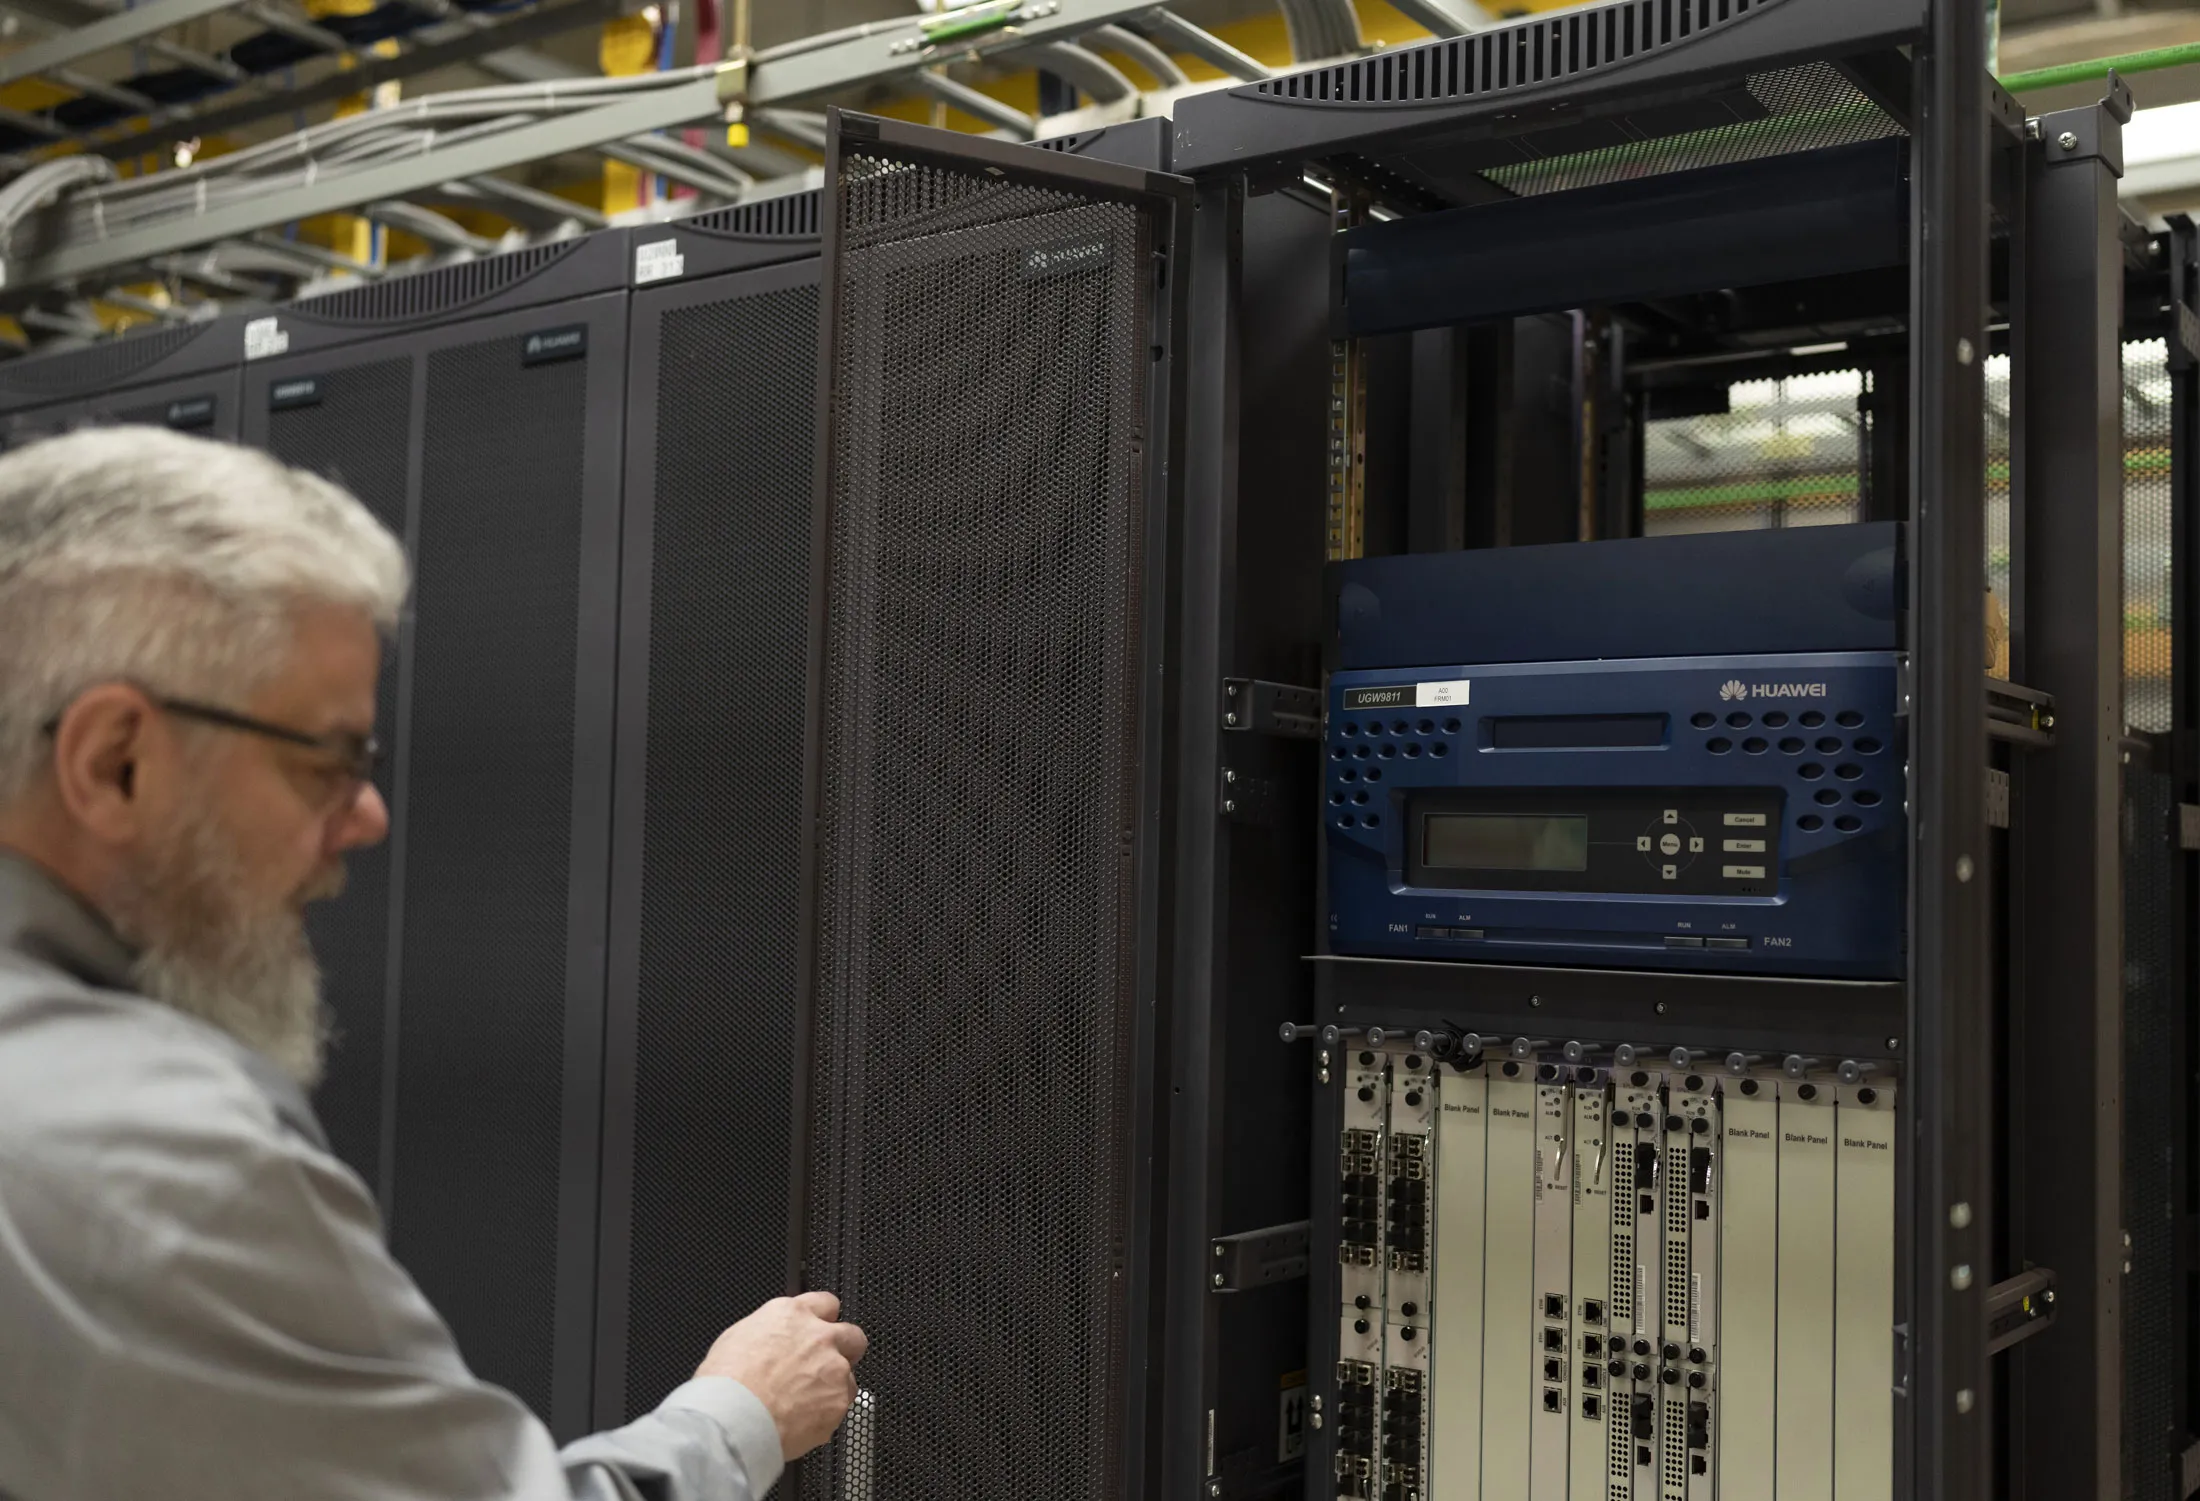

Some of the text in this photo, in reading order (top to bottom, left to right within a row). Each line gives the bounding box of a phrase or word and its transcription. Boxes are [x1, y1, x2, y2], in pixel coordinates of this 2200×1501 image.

[1752, 683, 1826, 698] HUAWEI
[1358, 691, 1401, 704] UGW9811
[1734, 816, 1755, 824] Cancel
[1388, 924, 1408, 933] FAN1
[1677, 921, 1692, 929] RUN
[1764, 937, 1792, 947] FAN2
[1444, 1103, 1480, 1114] Blank Panel
[1493, 1108, 1530, 1119] Blank Panel
[1728, 1128, 1770, 1139] Blank Panel
[1785, 1133, 1828, 1145] Blank Panel
[1844, 1138, 1888, 1150] Blank Panel
